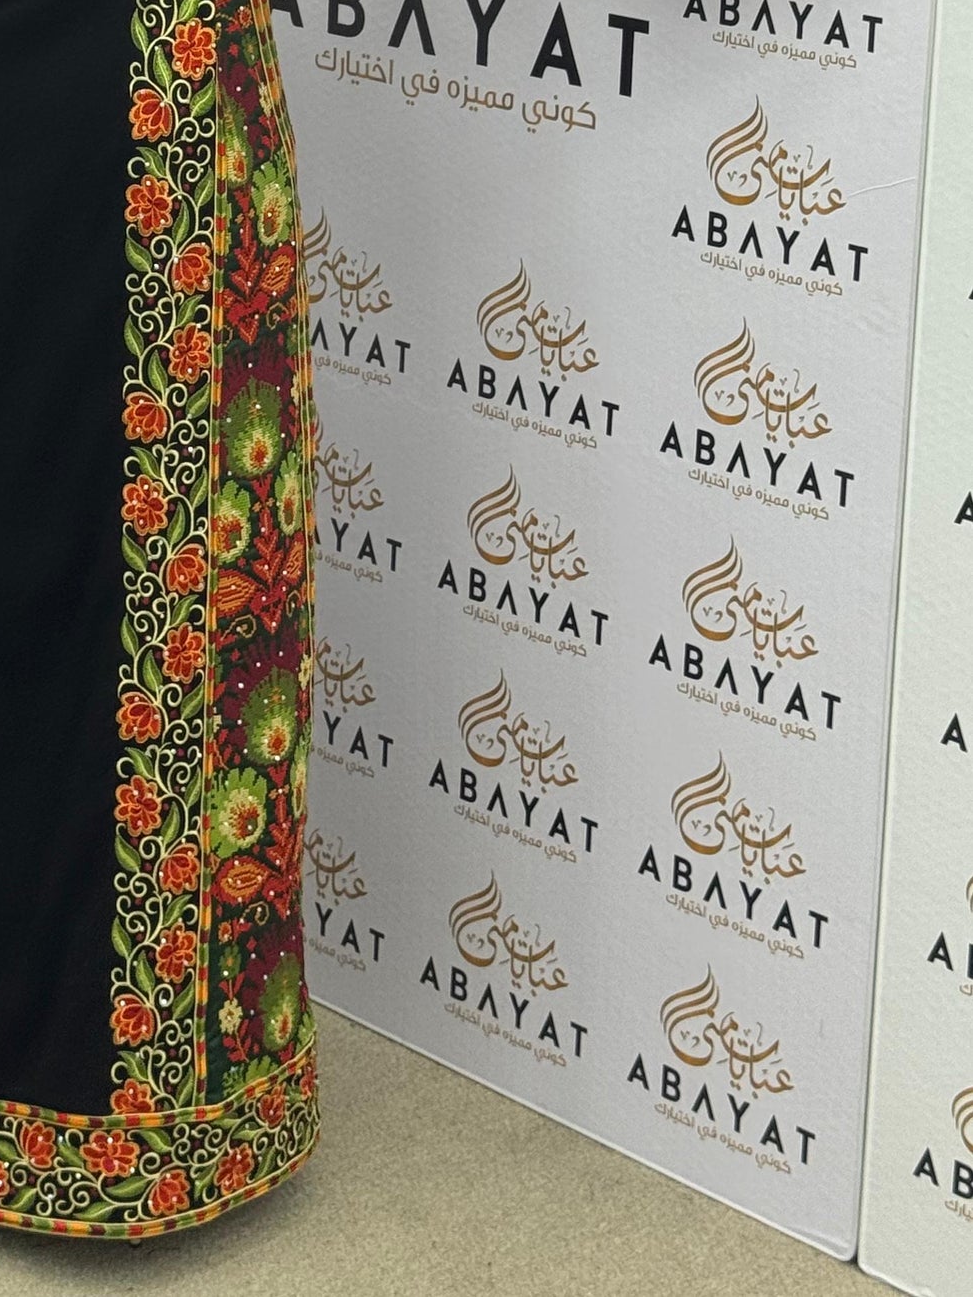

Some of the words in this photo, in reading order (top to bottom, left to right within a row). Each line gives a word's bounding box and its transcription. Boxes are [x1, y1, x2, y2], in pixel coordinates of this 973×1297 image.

[317, 46, 396, 86] اختيارك
[401, 68, 442, 106] في
[520, 93, 597, 134] كوني
[671, 205, 869, 282] ABAYAT
[744, 263, 766, 282] في
[805, 278, 843, 298] كوني
[310, 317, 411, 374] AYAT
[446, 357, 620, 437] ABAYAT
[659, 421, 855, 508] ABAYAT
[732, 483, 753, 501] في
[791, 501, 830, 521] كوني
[437, 559, 609, 646] ABAYAT
[648, 634, 842, 730] ABAYAT
[428, 759, 599, 853] ABAYAT
[637, 844, 829, 949] ABAYAT
[419, 956, 588, 1058] ABAYAT
[627, 1053, 816, 1165] ABAYAT
